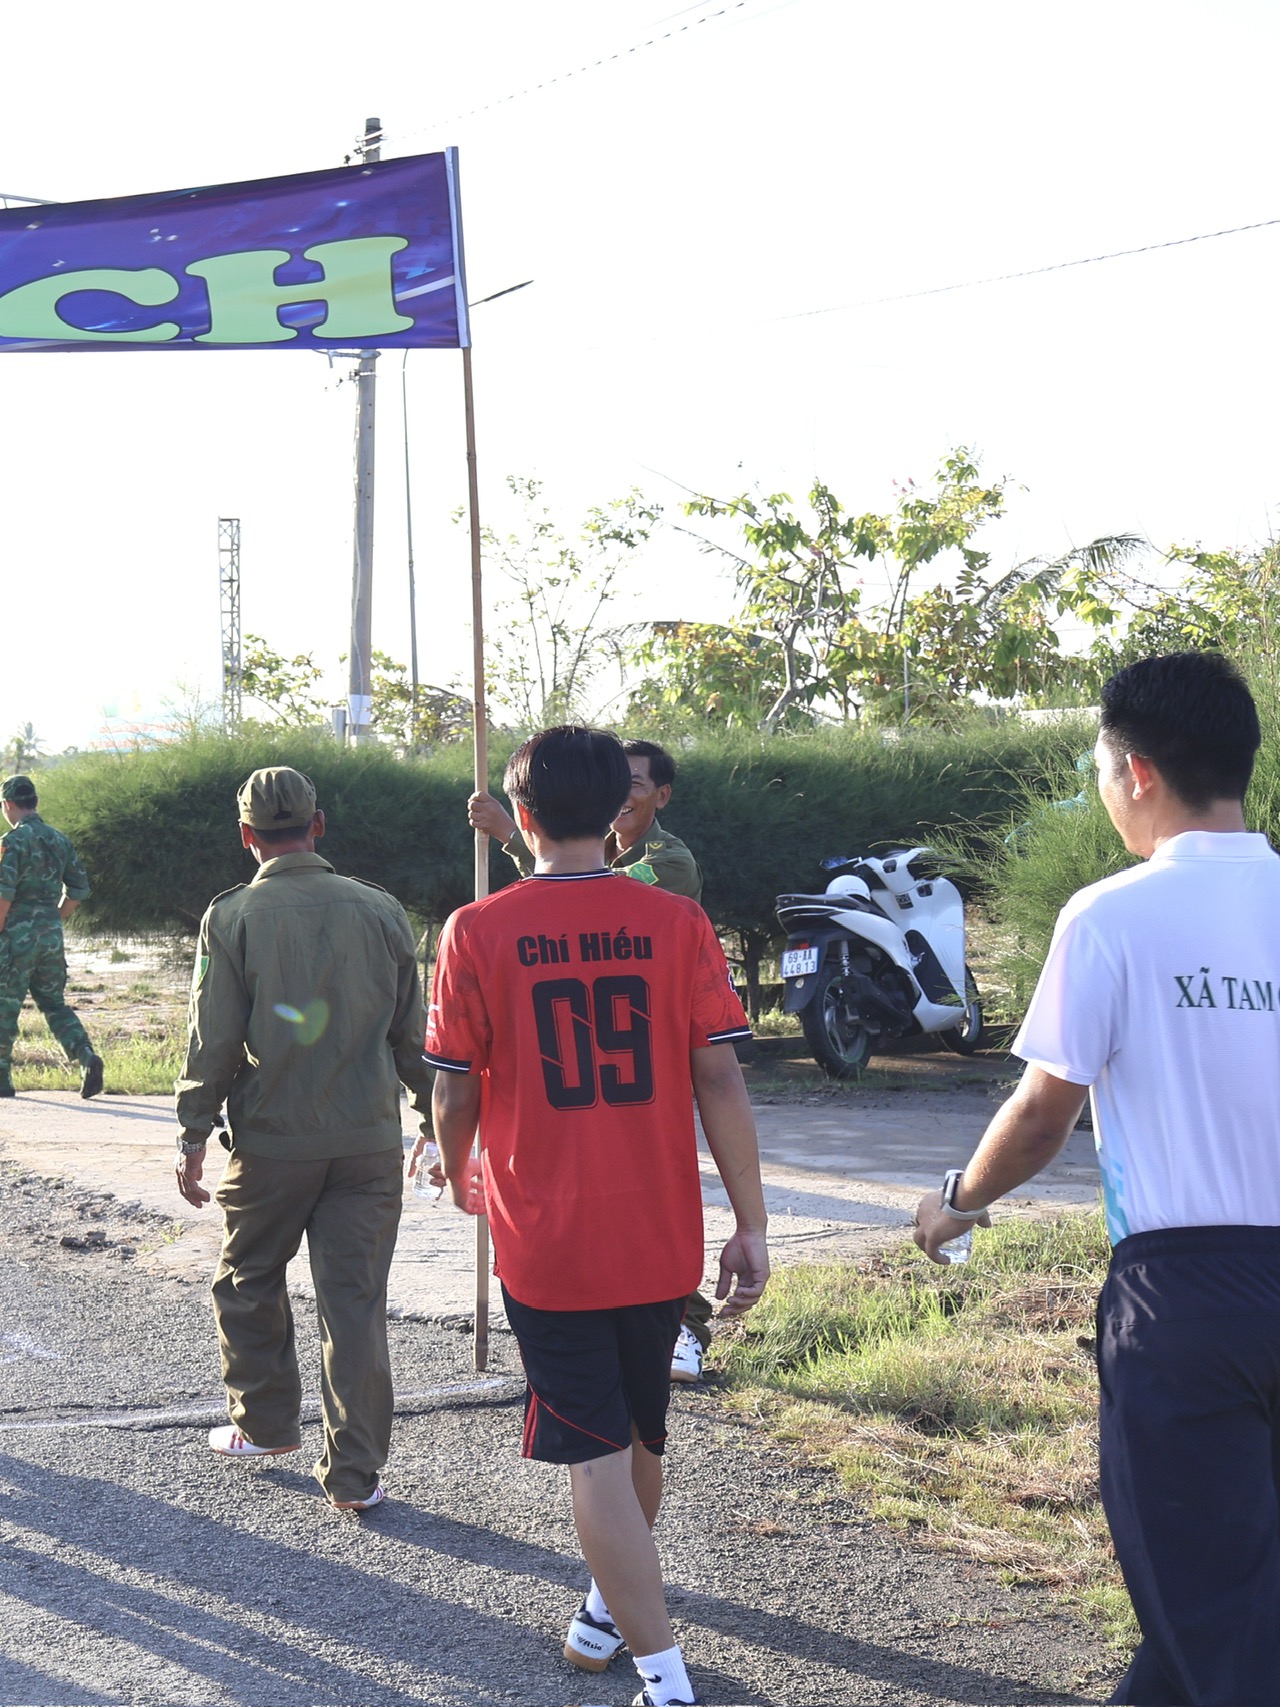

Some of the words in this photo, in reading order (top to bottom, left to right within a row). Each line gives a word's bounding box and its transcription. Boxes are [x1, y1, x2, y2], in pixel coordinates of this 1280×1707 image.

[516, 933, 570, 967] Chí
[578, 926, 653, 962] Hiếu
[1173, 966, 1217, 1008] XÃ
[1221, 976, 1276, 1012] TAM
[531, 975, 656, 1111] 09
